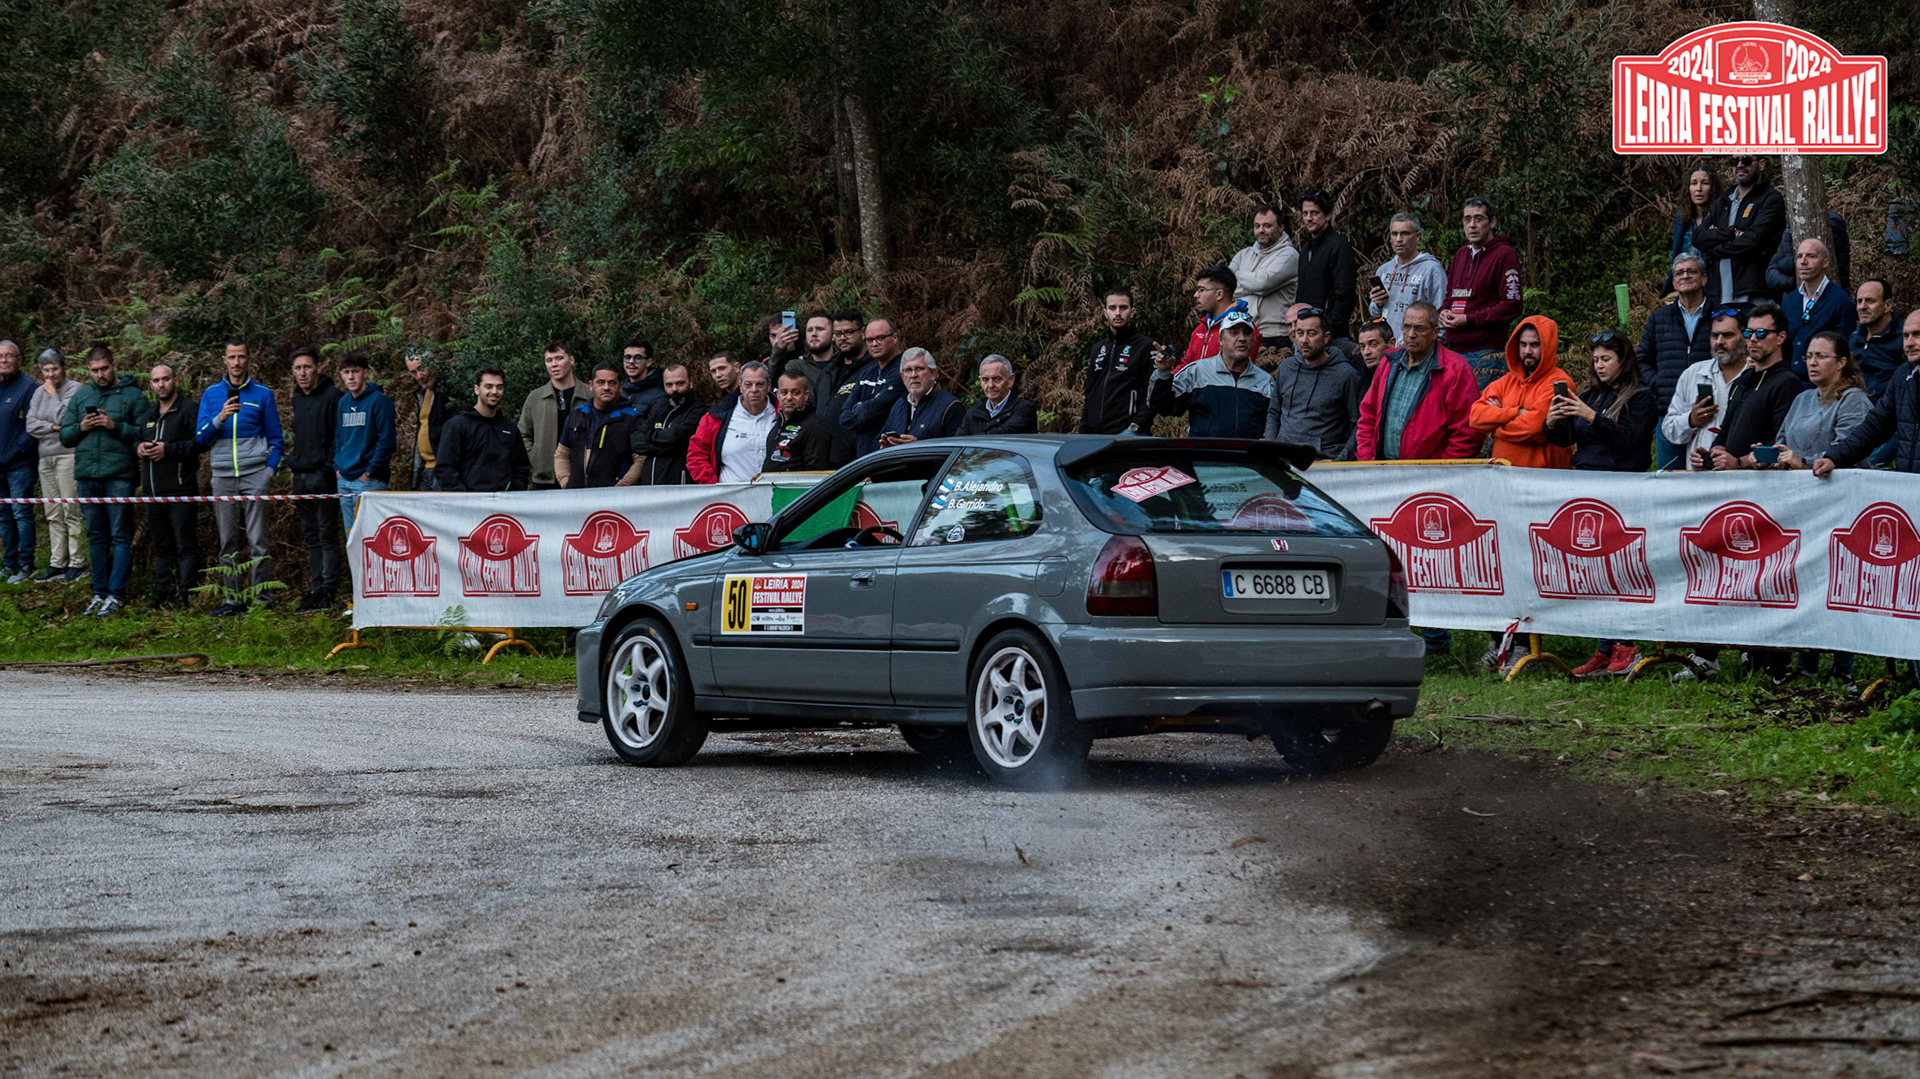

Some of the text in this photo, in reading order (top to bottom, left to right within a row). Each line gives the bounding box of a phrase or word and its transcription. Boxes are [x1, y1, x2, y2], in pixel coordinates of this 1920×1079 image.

[947, 498, 985, 509] B.Garrido
[954, 481, 1004, 494] B.Alejandro
[1410, 545, 1460, 588] FESTIVAL
[1459, 527, 1499, 589] RALLYE
[1532, 530, 1653, 597] LEIRIA FESTIVAL RALLYE
[1830, 536, 1859, 605] LEIRIA
[1858, 560, 1896, 610] FESTIVAL
[763, 578, 789, 590] LEIRIA
[1235, 574, 1325, 595] C 6688 CB
[1717, 556, 1761, 600] FESTIVAL
[728, 580, 747, 629] 50
[753, 591, 803, 604] FESTIVAL RALLYE
